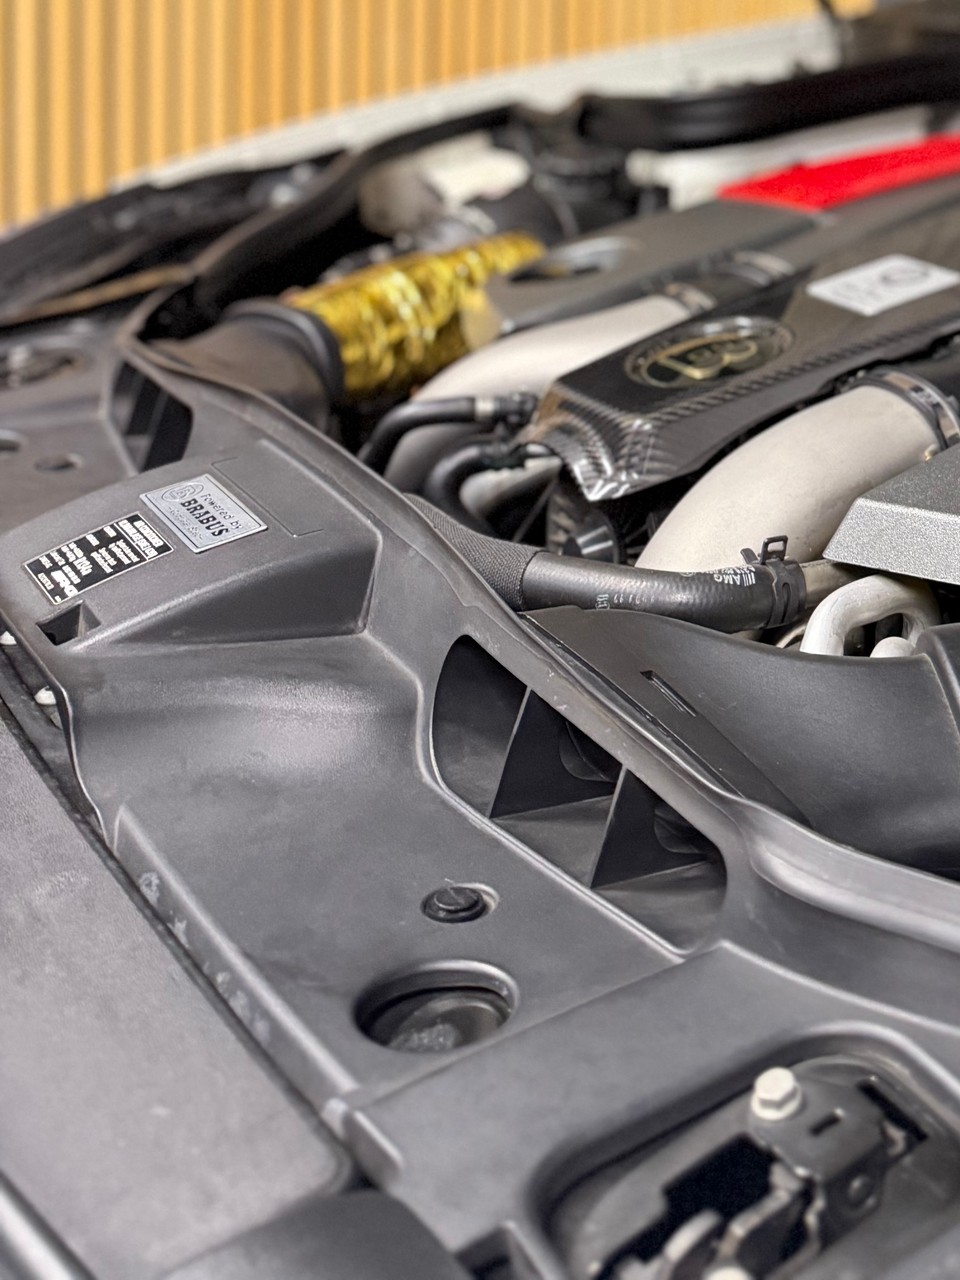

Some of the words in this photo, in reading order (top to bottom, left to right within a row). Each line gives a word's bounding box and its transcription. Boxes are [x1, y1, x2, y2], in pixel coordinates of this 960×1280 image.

[180, 498, 230, 537] BRABUS
[200, 493, 231, 521] Powered
[230, 519, 243, 530] by
[713, 573, 741, 586] AMG
